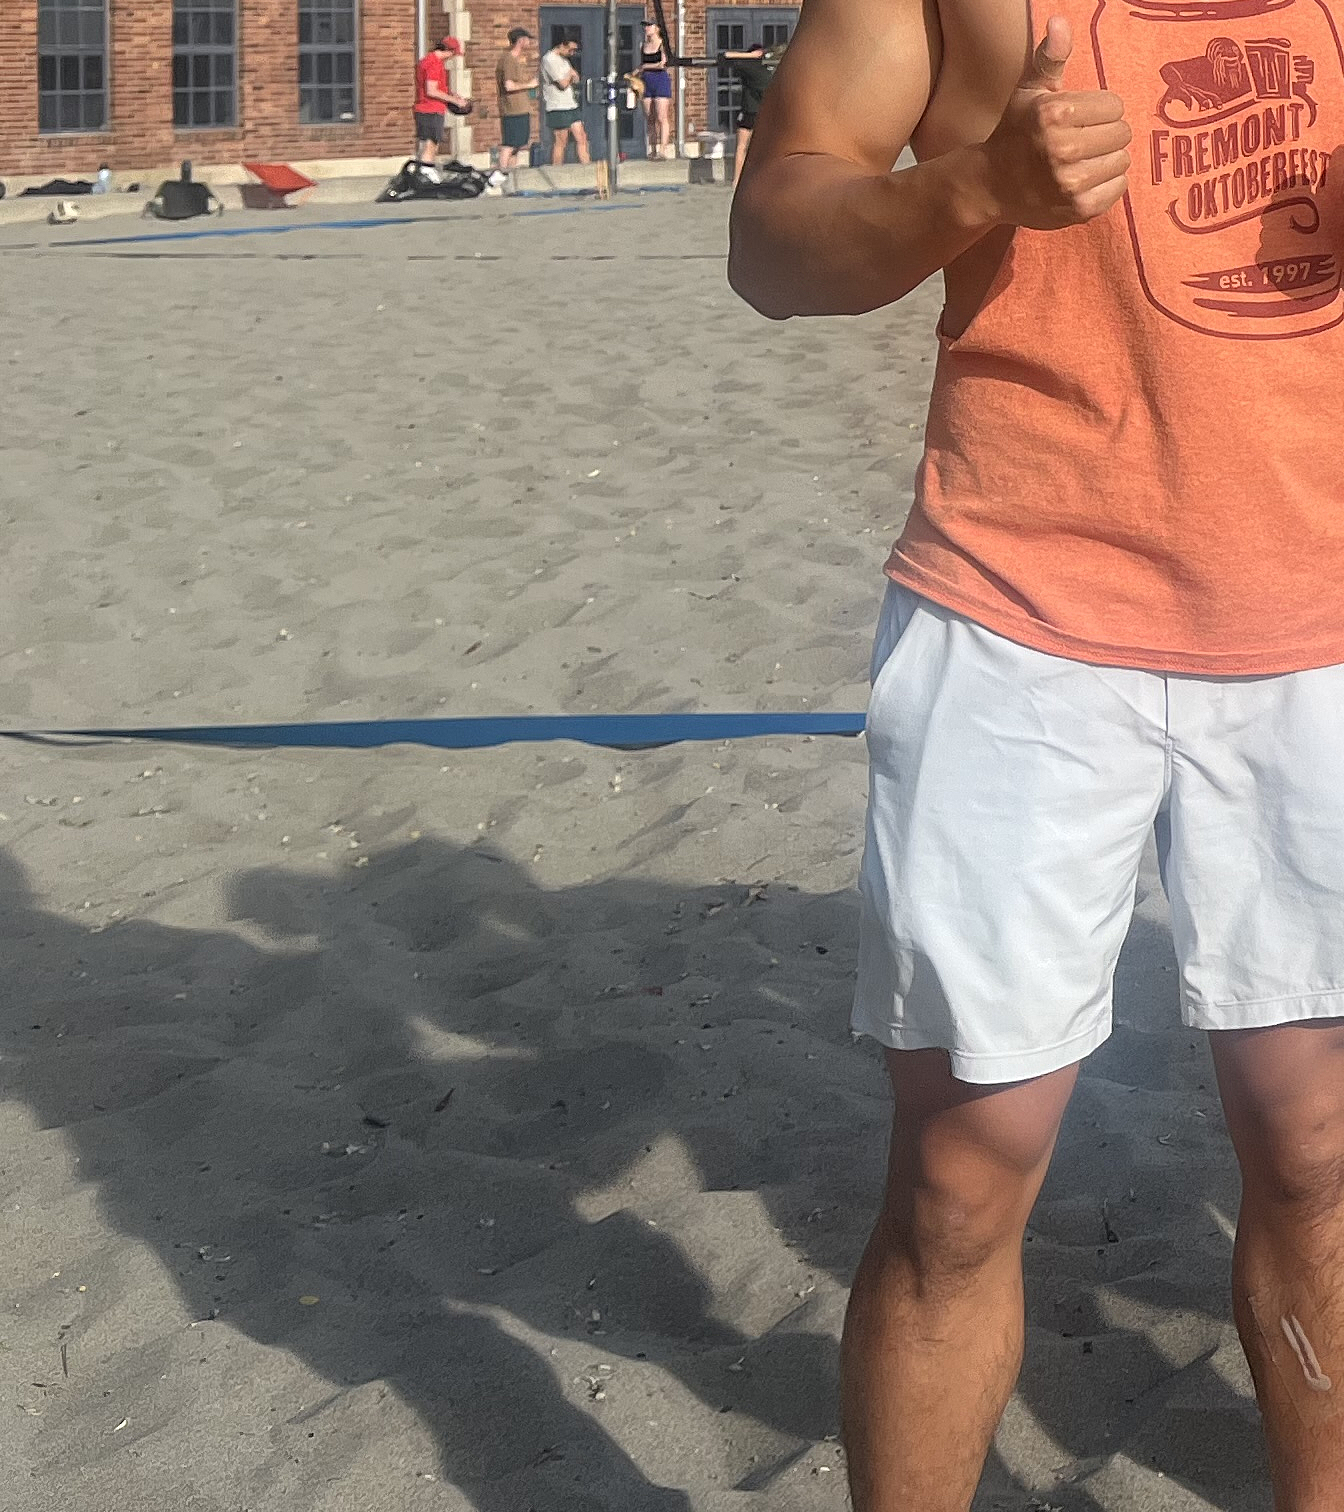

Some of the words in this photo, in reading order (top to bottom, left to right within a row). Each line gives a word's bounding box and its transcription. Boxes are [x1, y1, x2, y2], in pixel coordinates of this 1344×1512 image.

[1150, 102, 1304, 186] FREMONT
[1187, 148, 1332, 222] OKTOBERFEST
[1219, 271, 1253, 289] est.
[1261, 262, 1311, 285] 1997
